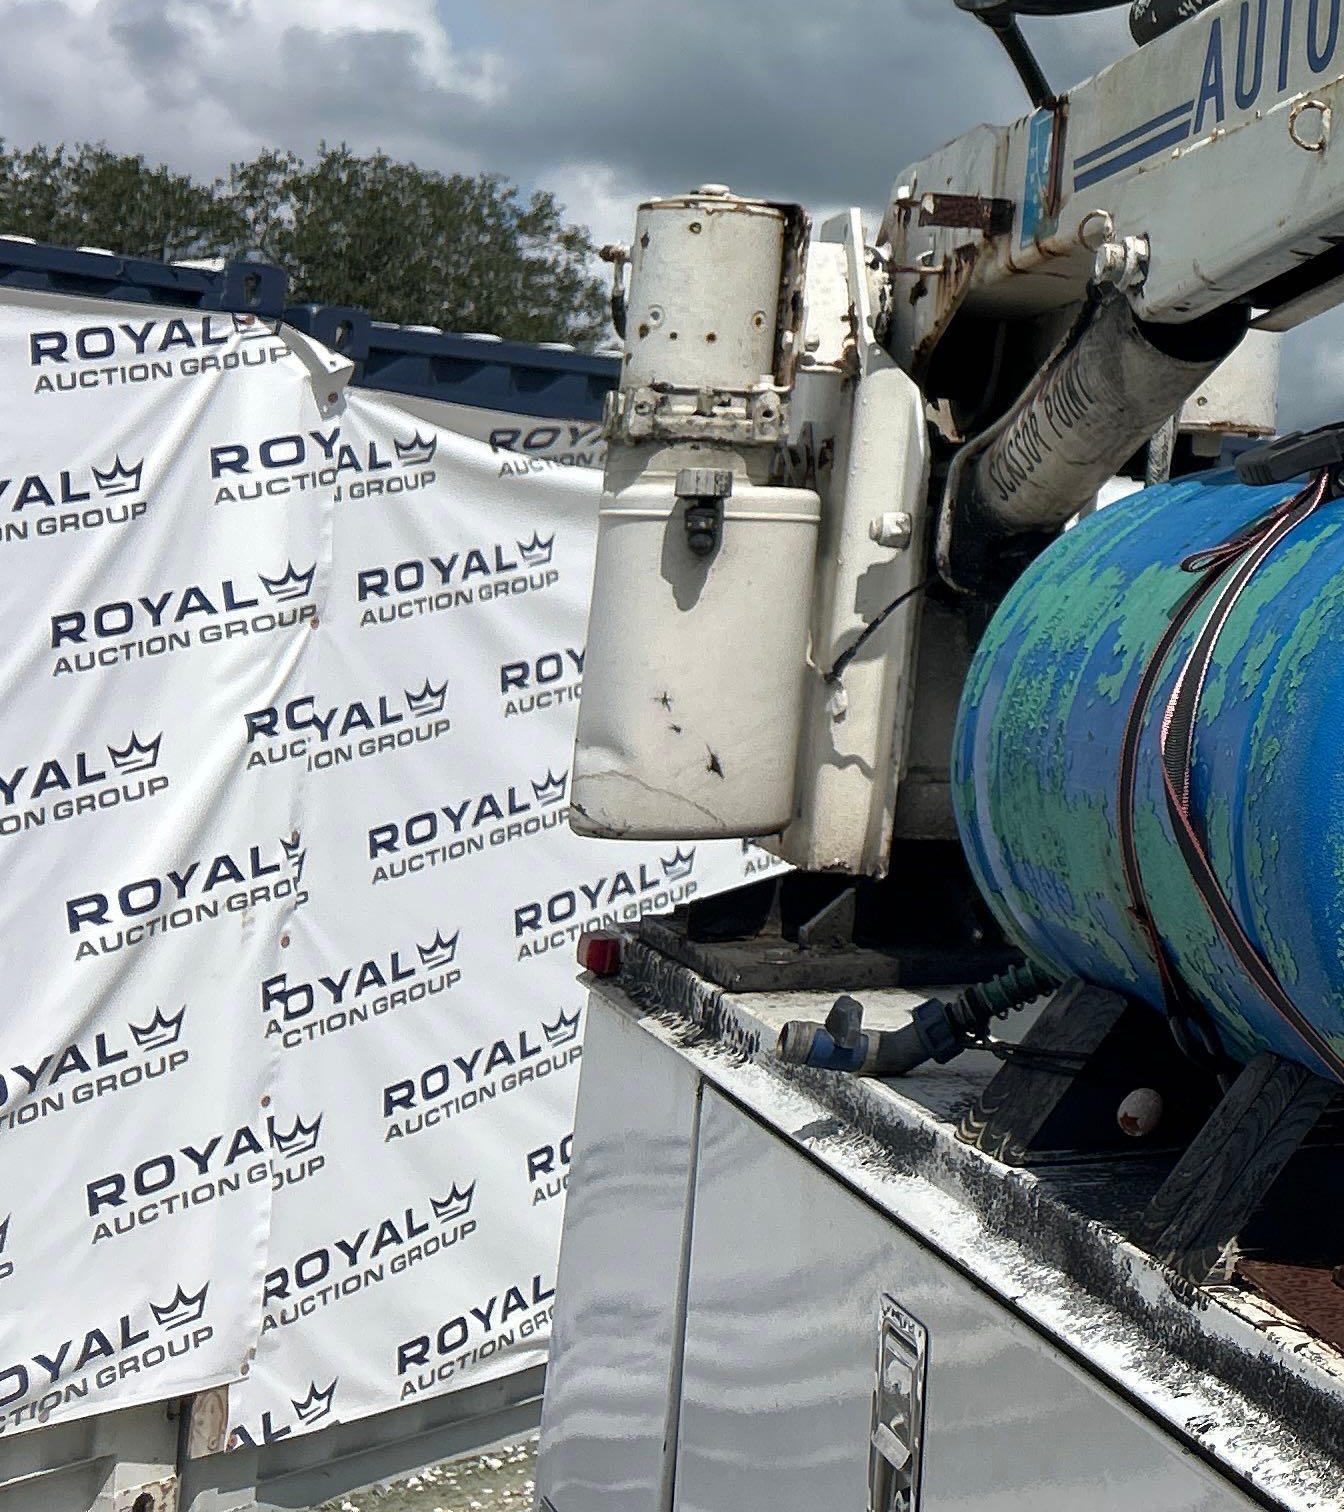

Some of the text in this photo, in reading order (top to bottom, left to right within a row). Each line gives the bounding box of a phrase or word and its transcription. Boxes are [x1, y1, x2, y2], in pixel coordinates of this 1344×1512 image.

[30, 316, 229, 367] ROYAL
[34, 346, 293, 394] AUCTION GROUP
[210, 427, 393, 479] ROYAL
[489, 426, 600, 453] ROY
[498, 452, 594, 478] AUCON
[36, 501, 147, 537] GROUP
[349, 470, 436, 500] GROUP
[357, 543, 518, 602] ROYAL
[359, 569, 559, 628] AUCTION GROUP
[51, 580, 259, 649] ROYAL
[53, 603, 317, 677] AUCTION GROUP
[500, 647, 586, 694] ROY
[504, 684, 582, 719] AUCTI
[244, 695, 403, 744] ROYAL
[246, 718, 451, 773] AUCION GROUP
[0, 751, 106, 806] YAL
[53, 776, 169, 821] GROUP
[368, 786, 531, 860] ROYAL
[372, 806, 571, 885] AUCTION GROUP
[66, 845, 280, 934] ROYAL
[514, 863, 660, 938] ROYAL
[518, 880, 698, 962] AUCTION GROUP
[75, 900, 219, 962] AUCTION
[264, 968, 461, 1049] ACTION GROUP
[0, 1032, 128, 1107] YAL
[72, 1049, 189, 1105] GROUP
[383, 1030, 542, 1119] ROYAL
[384, 1045, 584, 1143] AUCTION GROUP
[91, 1155, 325, 1245] AUCTION GUP
[260, 1219, 477, 1336] AUCTION GROUP
[262, 1207, 430, 1308] ROYAL
[398, 1274, 556, 1376] ROYAL
[0, 1314, 150, 1408] OYAL
[0, 1325, 213, 1433] TION GROUP
[400, 1328, 515, 1401] AUCTION
